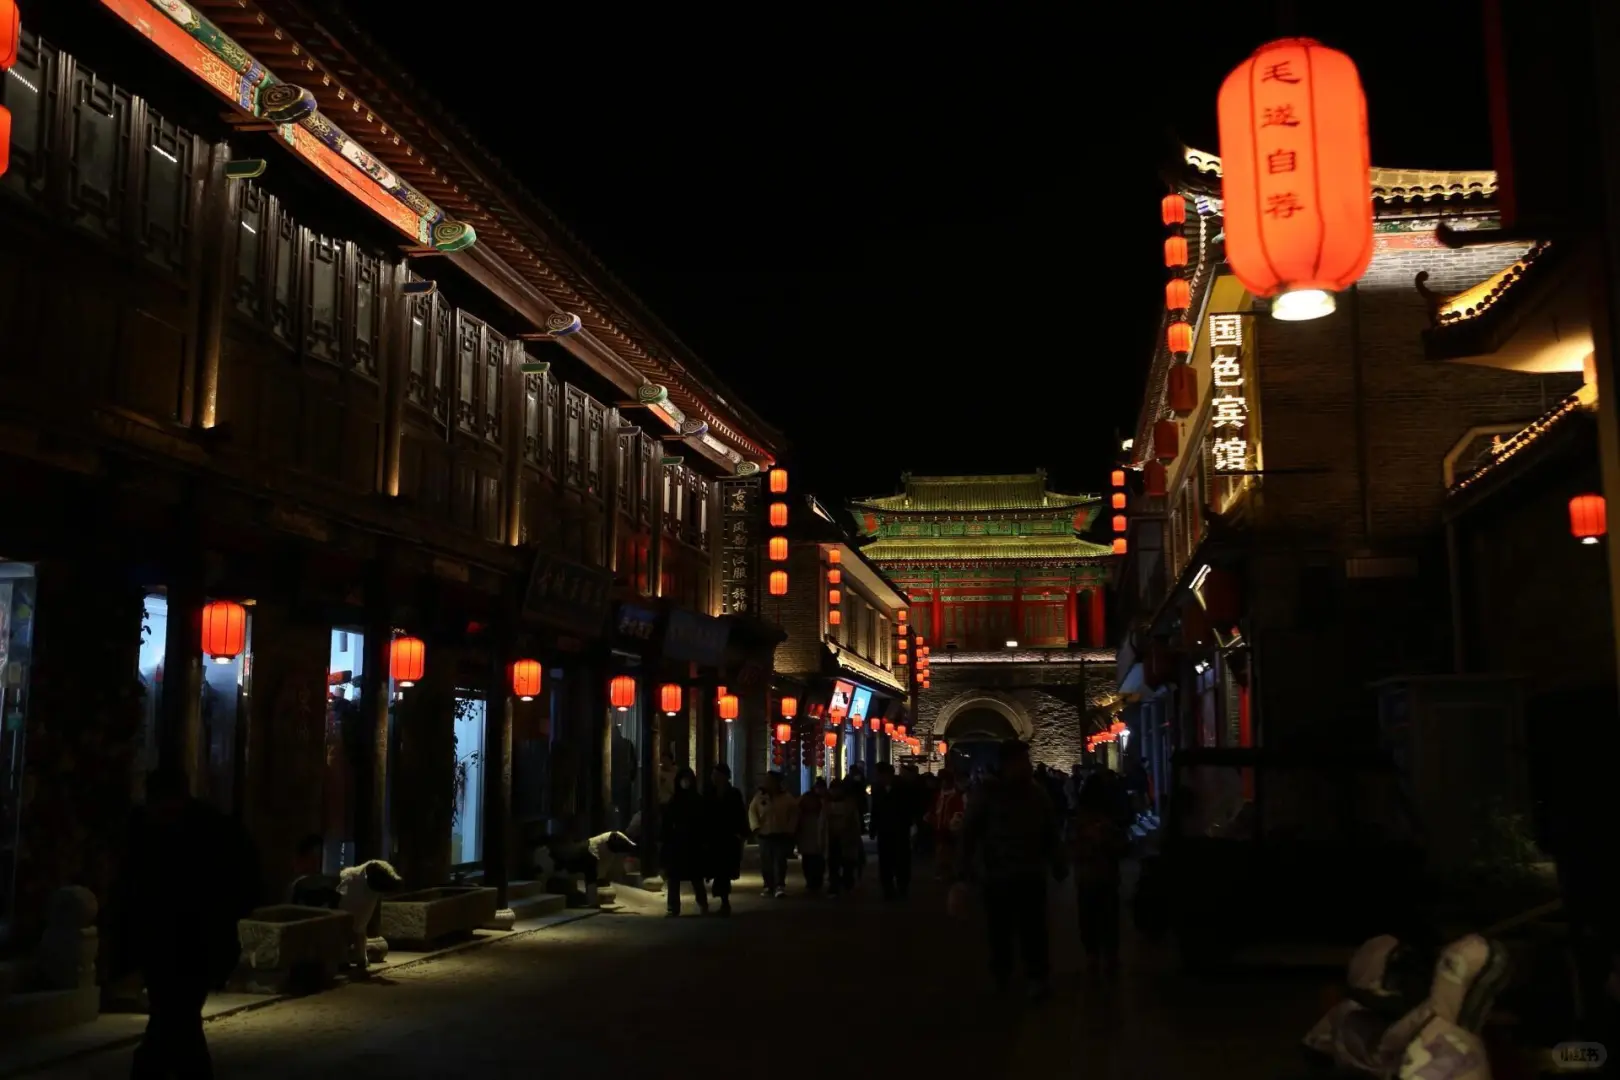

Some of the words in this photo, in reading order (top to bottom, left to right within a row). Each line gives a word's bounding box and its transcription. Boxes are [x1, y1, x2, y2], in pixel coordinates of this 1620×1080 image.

[1261, 61, 1304, 218] 毛遂自荐
[1209, 314, 1248, 470] 国色宾馆
